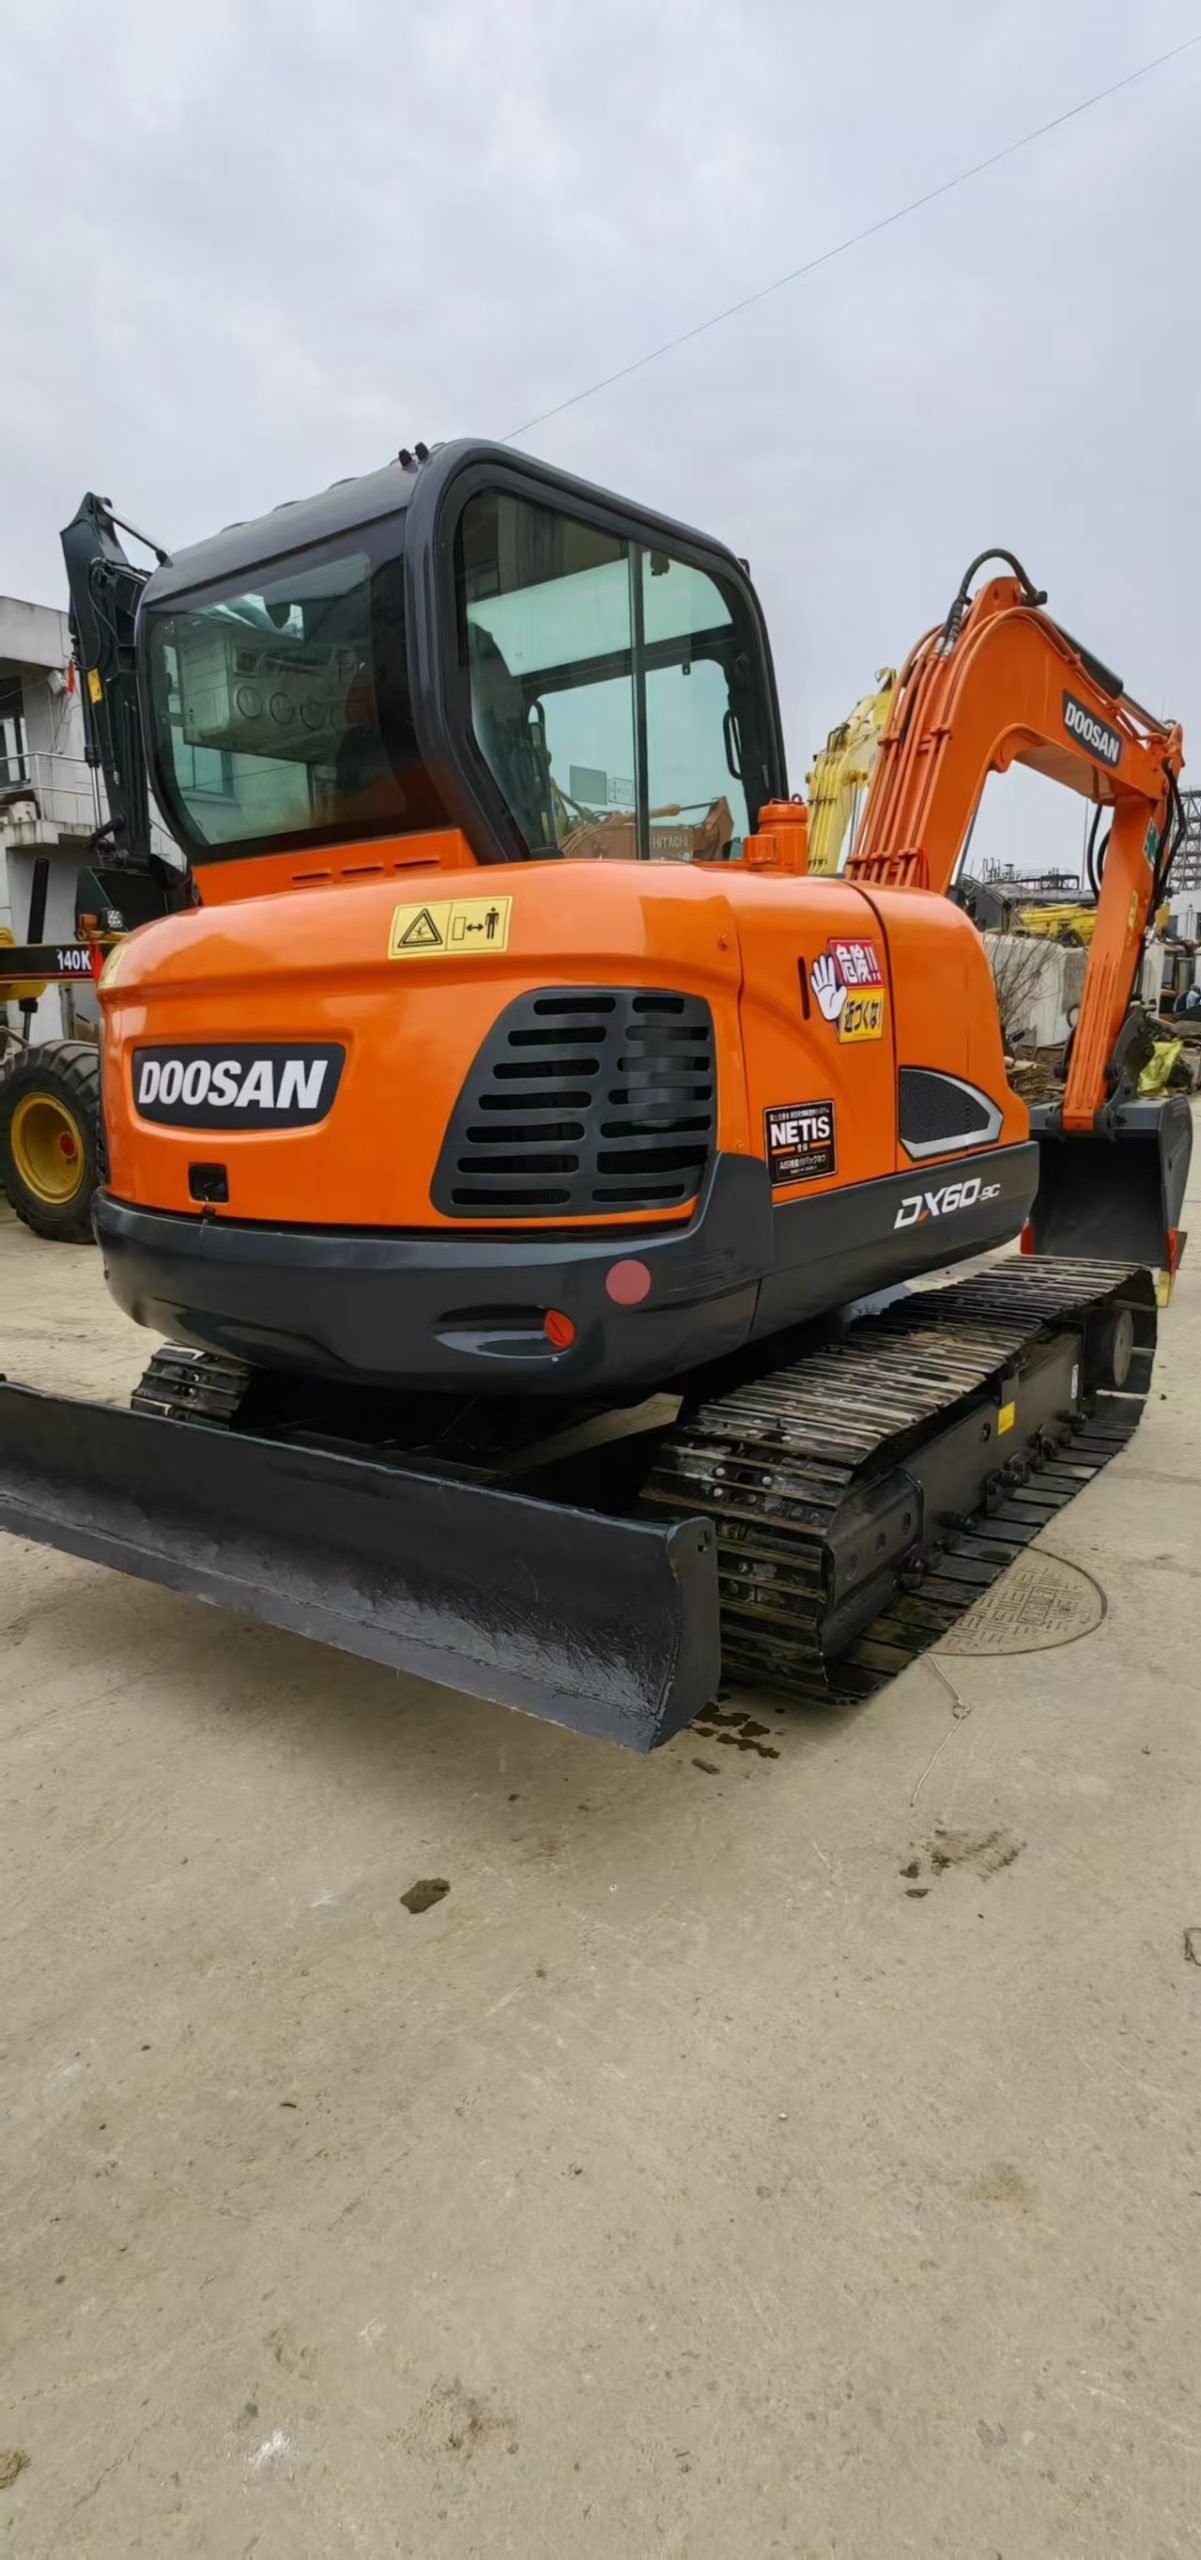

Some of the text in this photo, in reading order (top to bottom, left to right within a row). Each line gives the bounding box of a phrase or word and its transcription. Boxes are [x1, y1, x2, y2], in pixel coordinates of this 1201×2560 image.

[1064, 702, 1120, 763] DOOSAN
[652, 833, 689, 849] HITACHI
[57, 950, 92, 970] 140K
[138, 1060, 329, 1110] DOOSAN
[770, 1116, 831, 1147] NETIS
